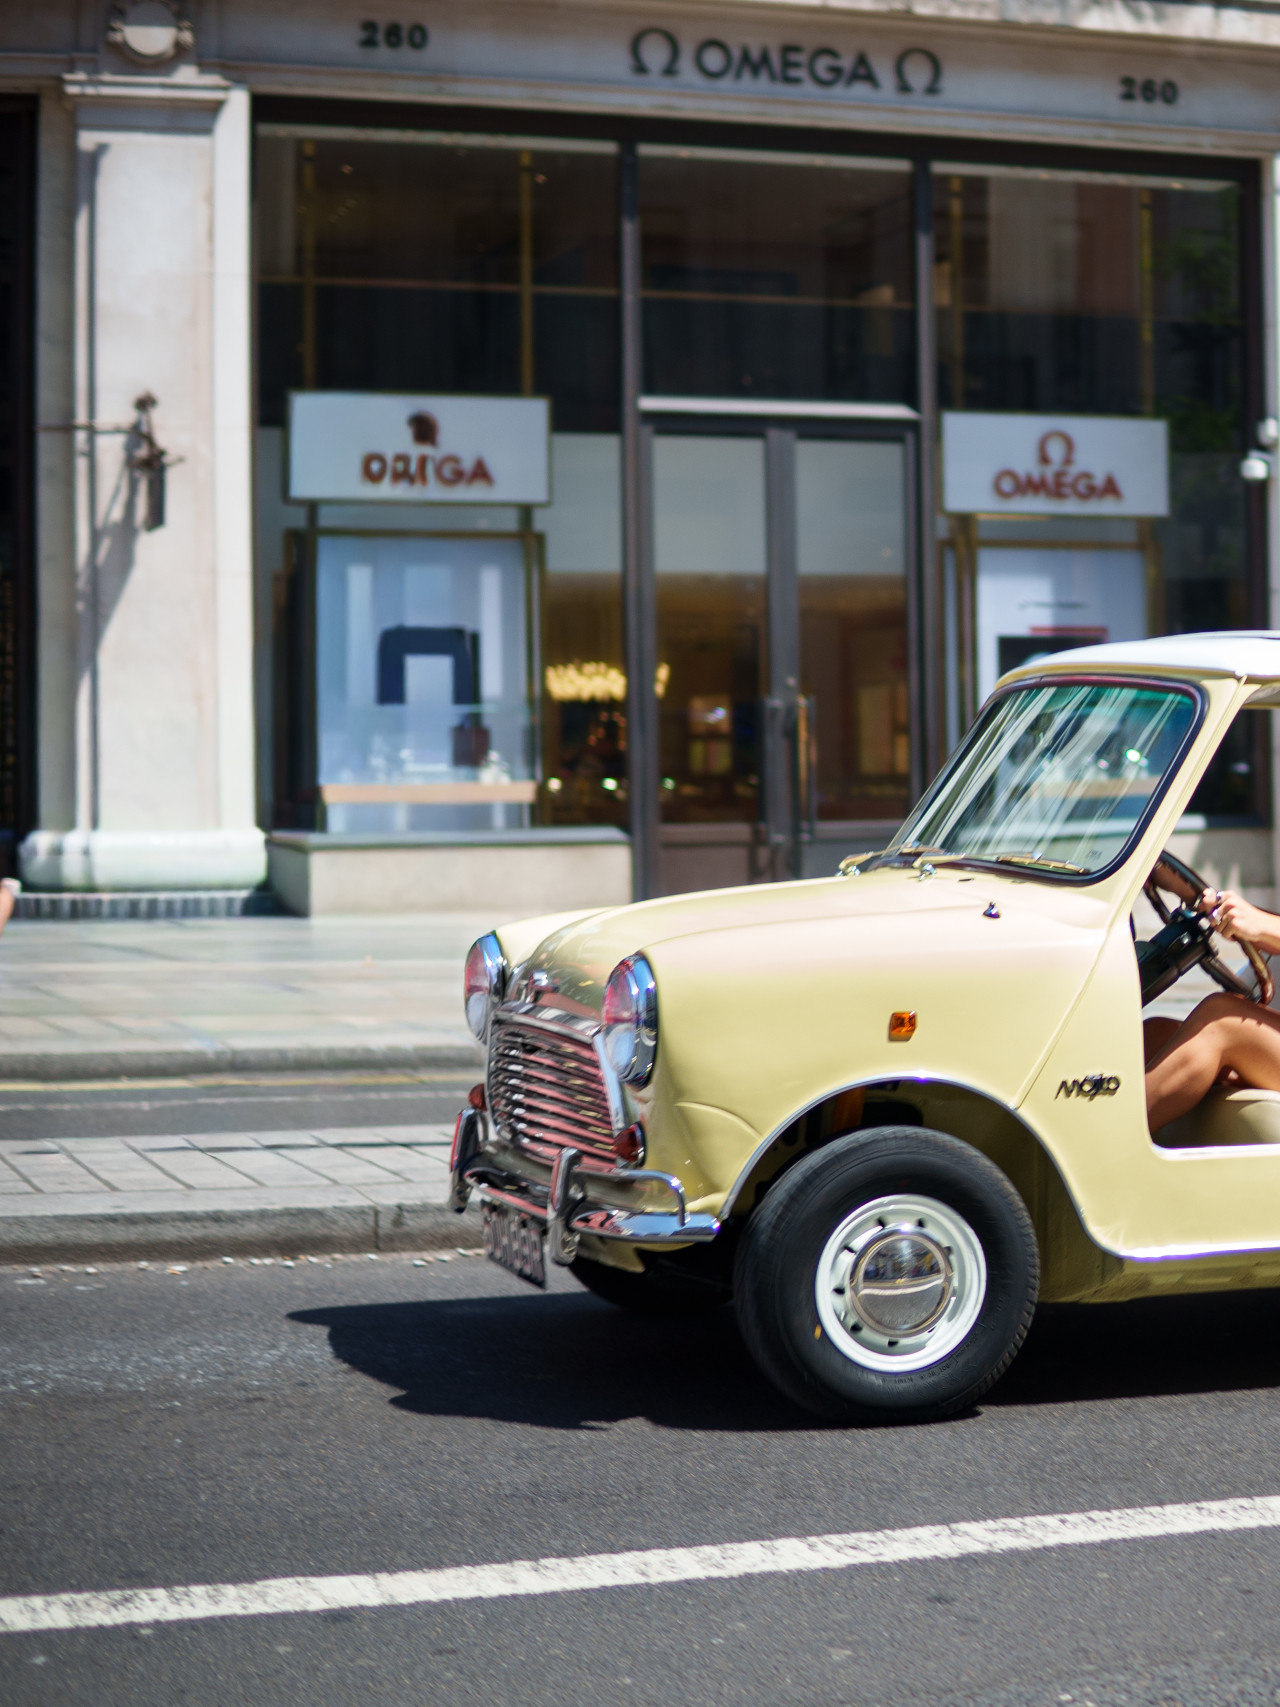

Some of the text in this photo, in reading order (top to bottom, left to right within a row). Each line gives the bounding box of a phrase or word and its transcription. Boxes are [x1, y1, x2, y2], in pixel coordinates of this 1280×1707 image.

[358, 20, 429, 50] 260
[695, 38, 880, 90] OMEGA
[1119, 75, 1178, 106] 260
[362, 451, 495, 488] OGA
[993, 468, 1124, 502] OMEGA
